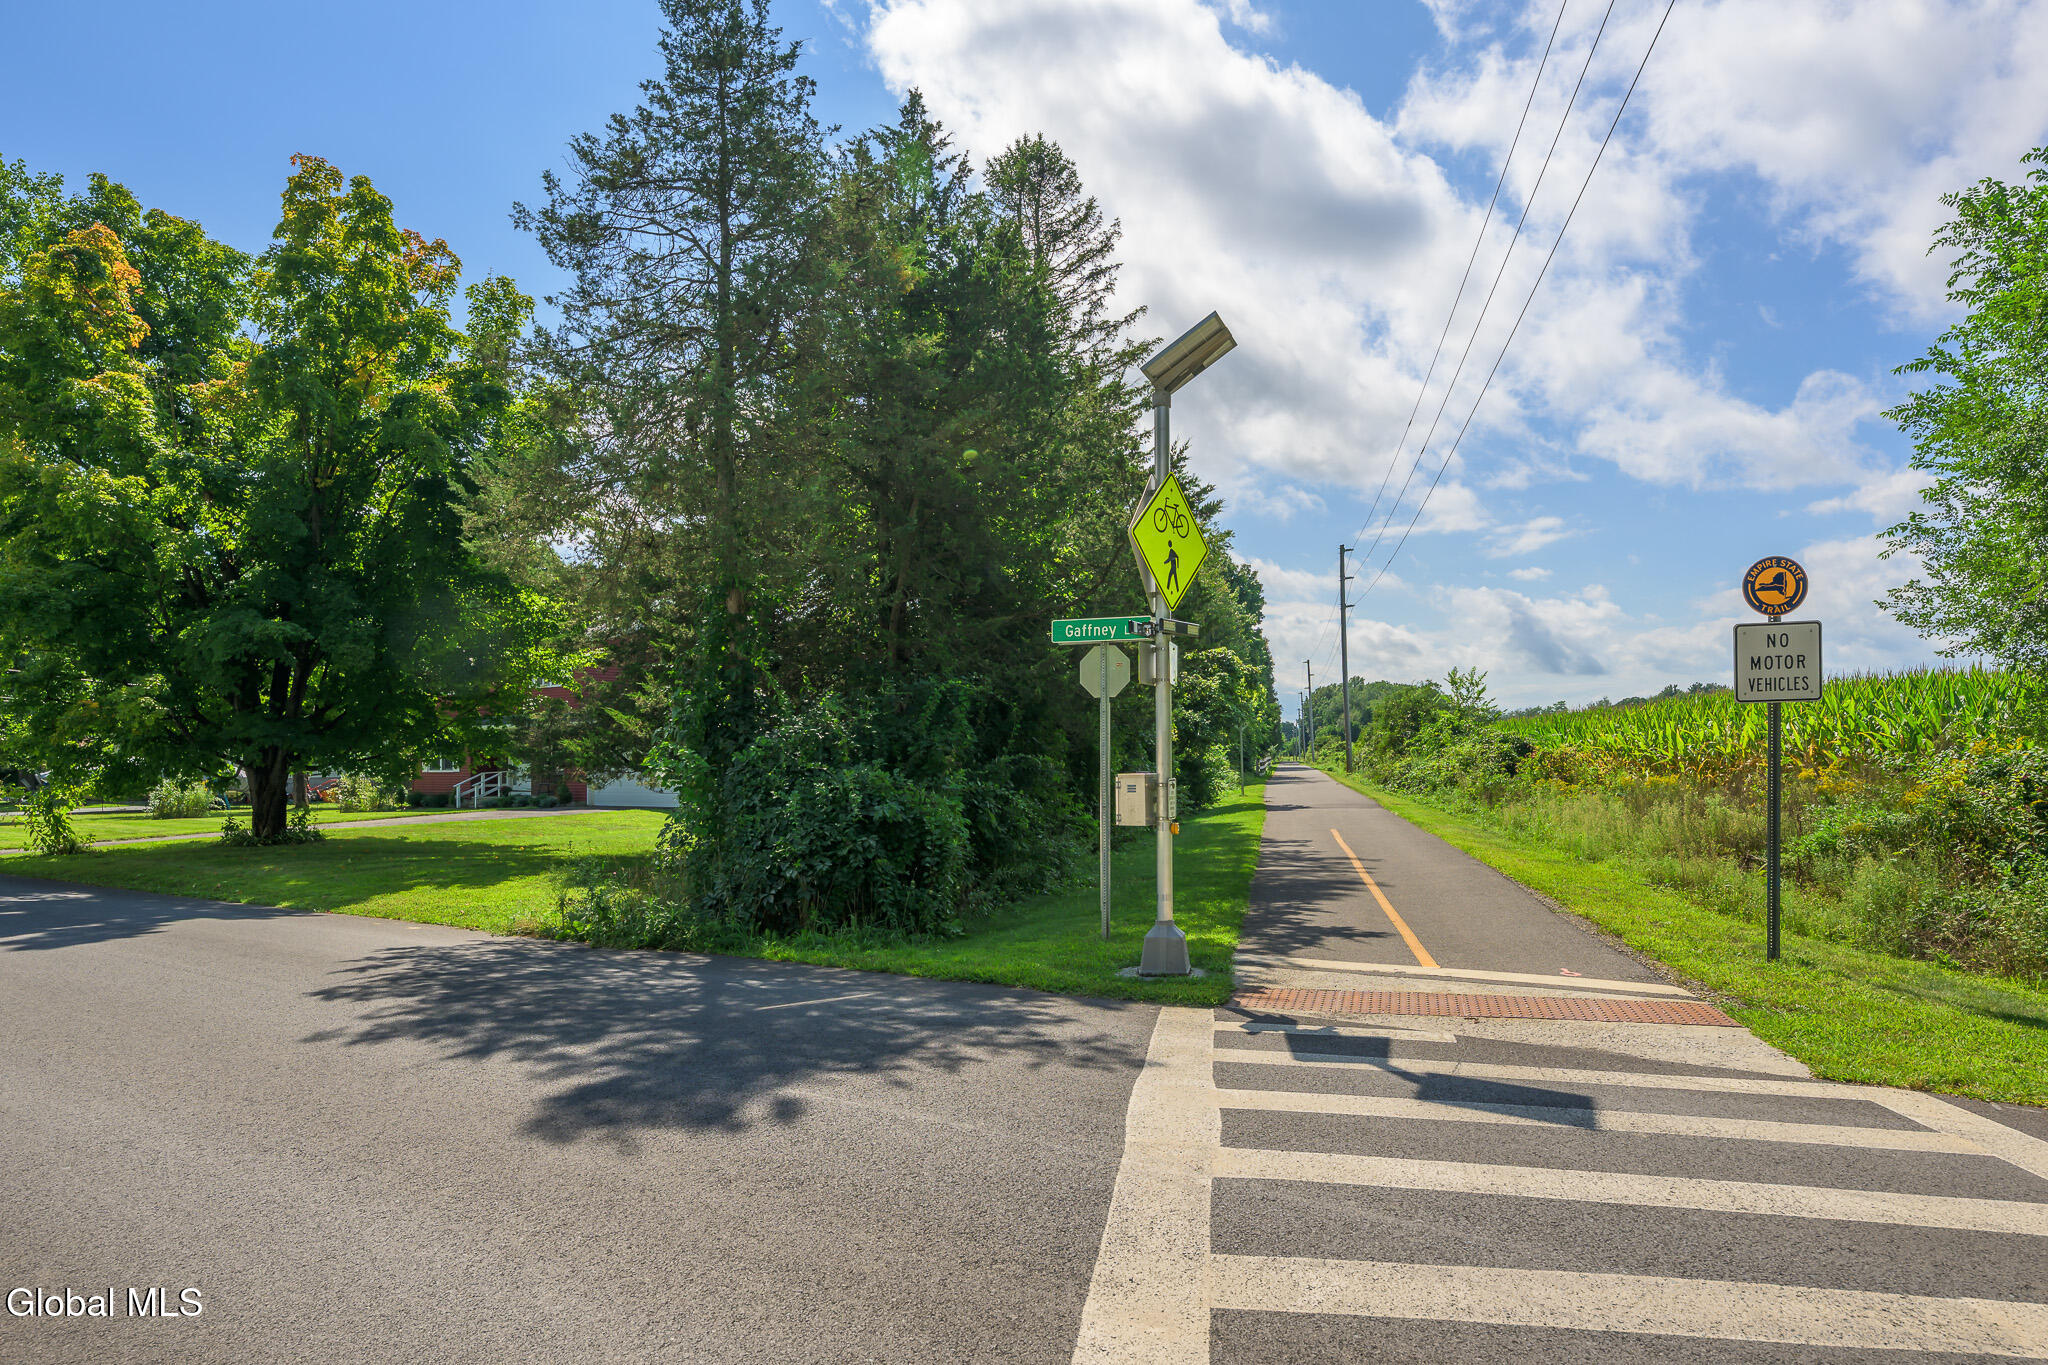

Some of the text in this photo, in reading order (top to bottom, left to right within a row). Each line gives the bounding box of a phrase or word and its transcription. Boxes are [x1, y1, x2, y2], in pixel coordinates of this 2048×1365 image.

[1747, 558, 1804, 582] EMPIRE STATE
[1761, 603, 1791, 614] TRAIL
[1065, 624, 1117, 639] Gaffney
[1766, 632, 1789, 648] NO
[1750, 654, 1806, 671] MOTOR
[1748, 675, 1809, 692] VEHICLES
